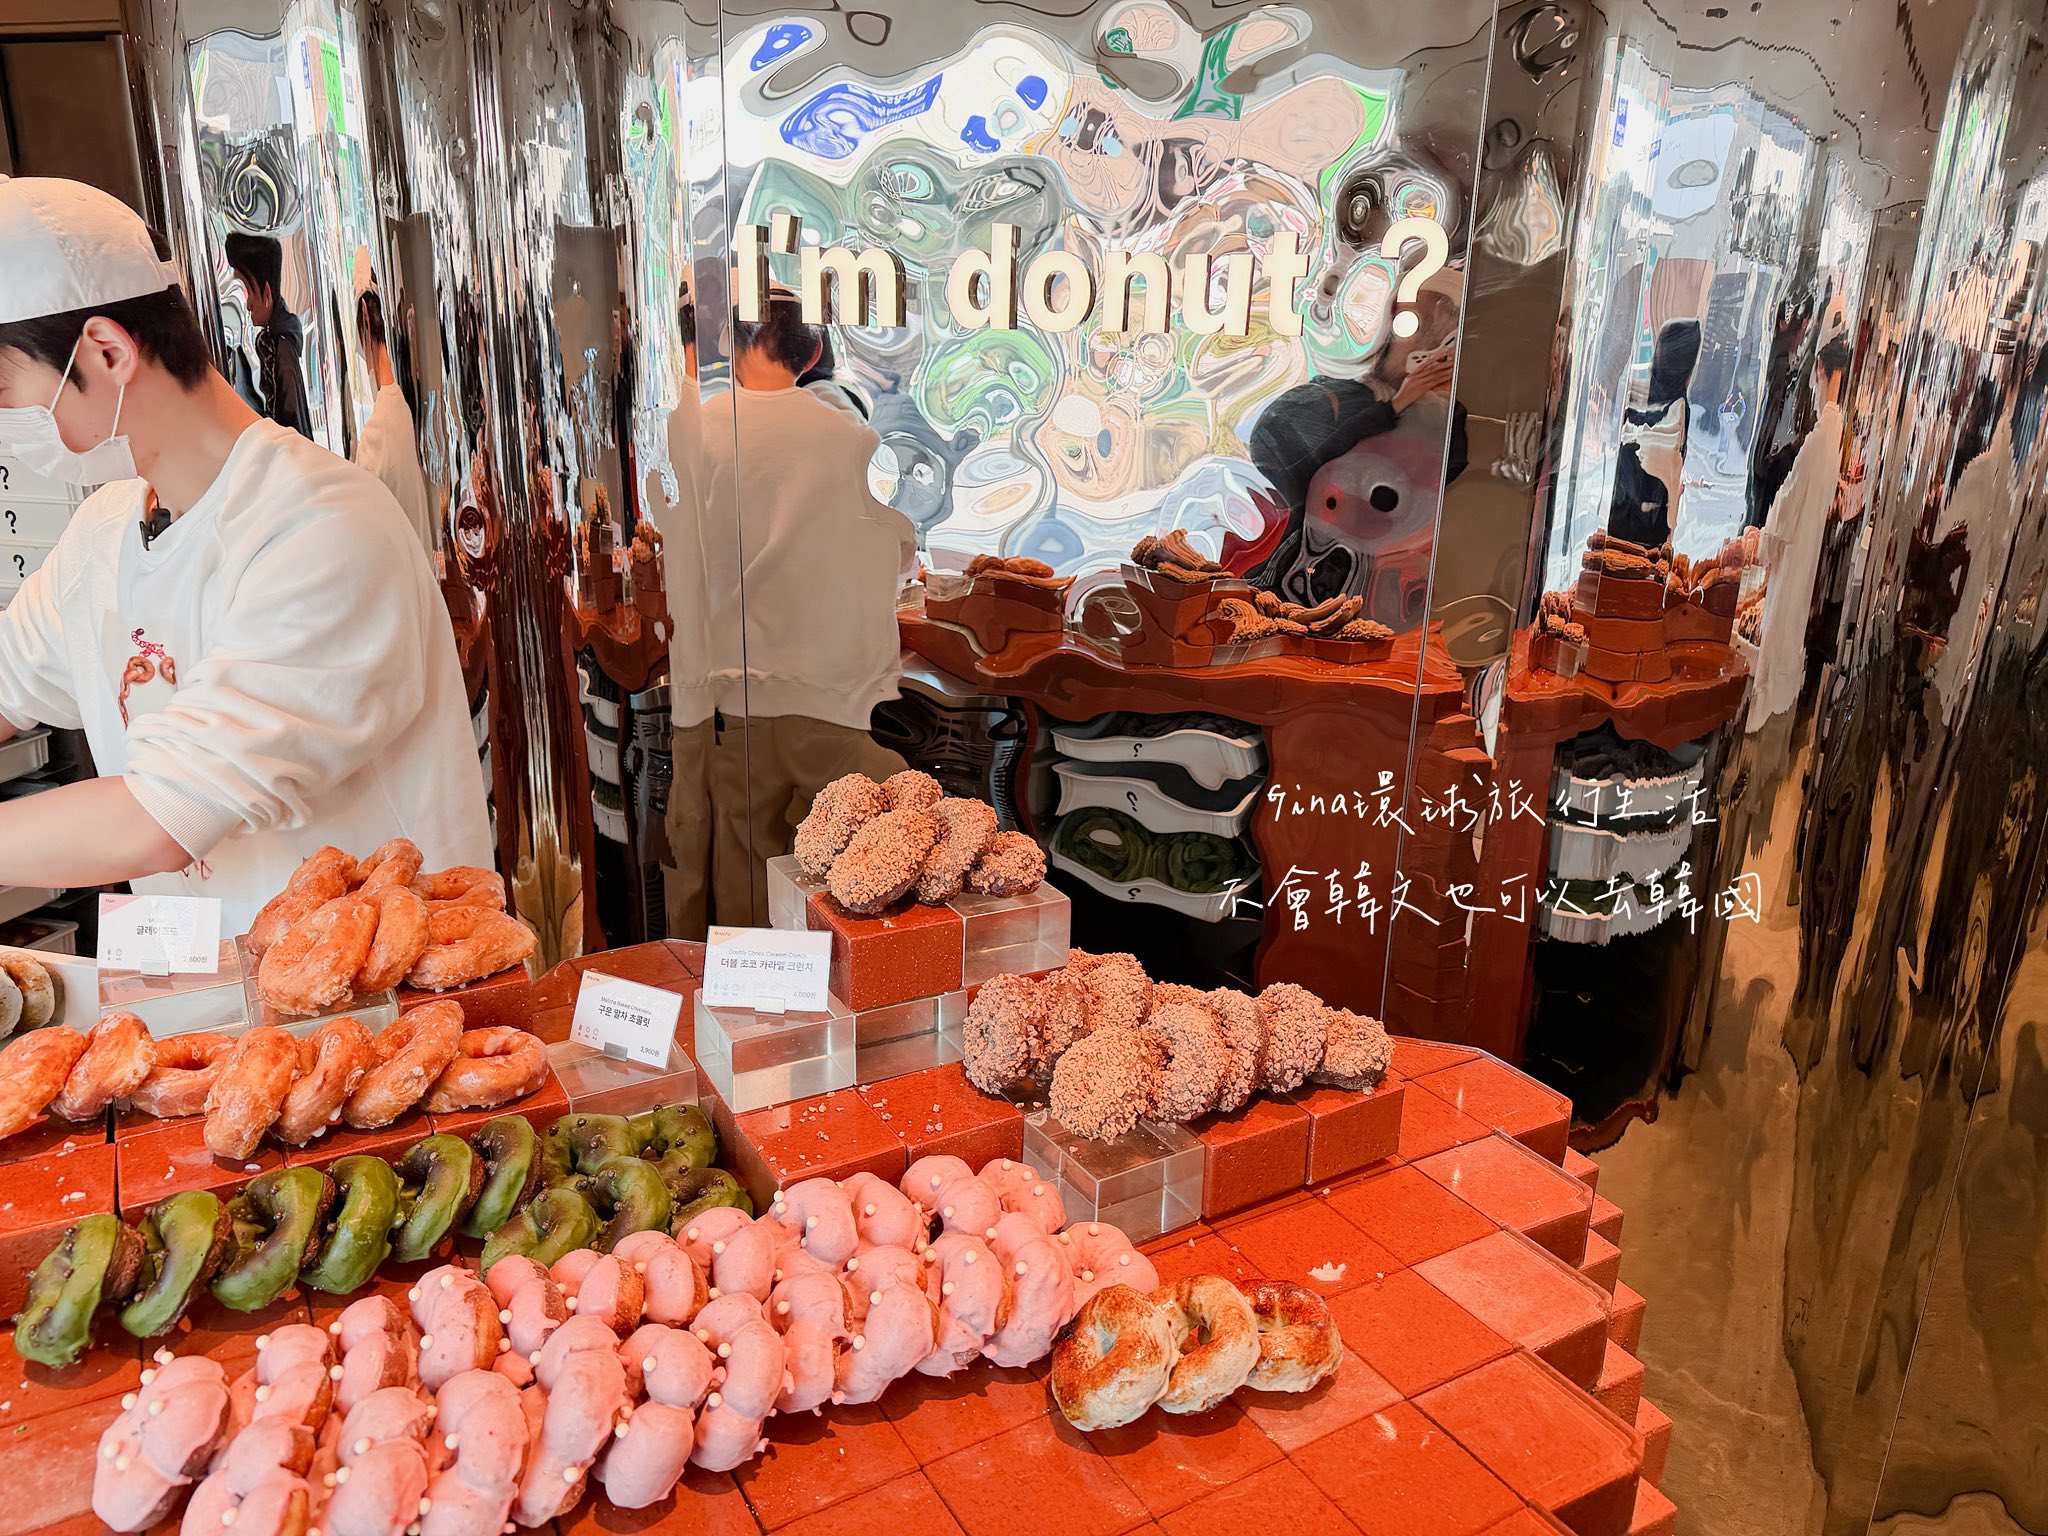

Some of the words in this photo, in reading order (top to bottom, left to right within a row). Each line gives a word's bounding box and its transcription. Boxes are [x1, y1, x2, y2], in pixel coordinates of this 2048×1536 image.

[737, 214, 905, 327] I'm
[946, 222, 1309, 336] donut
[1380, 219, 1450, 338] ?
[5, 510, 17, 534] ?
[13, 554, 25, 578] ?
[720, 957, 738, 969] 더블
[740, 958, 758, 969] 초코
[787, 961, 814, 973] 크런치
[598, 1004, 613, 1017] 구운
[613, 1008, 628, 1021] 말차
[628, 1013, 651, 1028] 초콜릿
[639, 1045, 660, 1058] 3,900원
